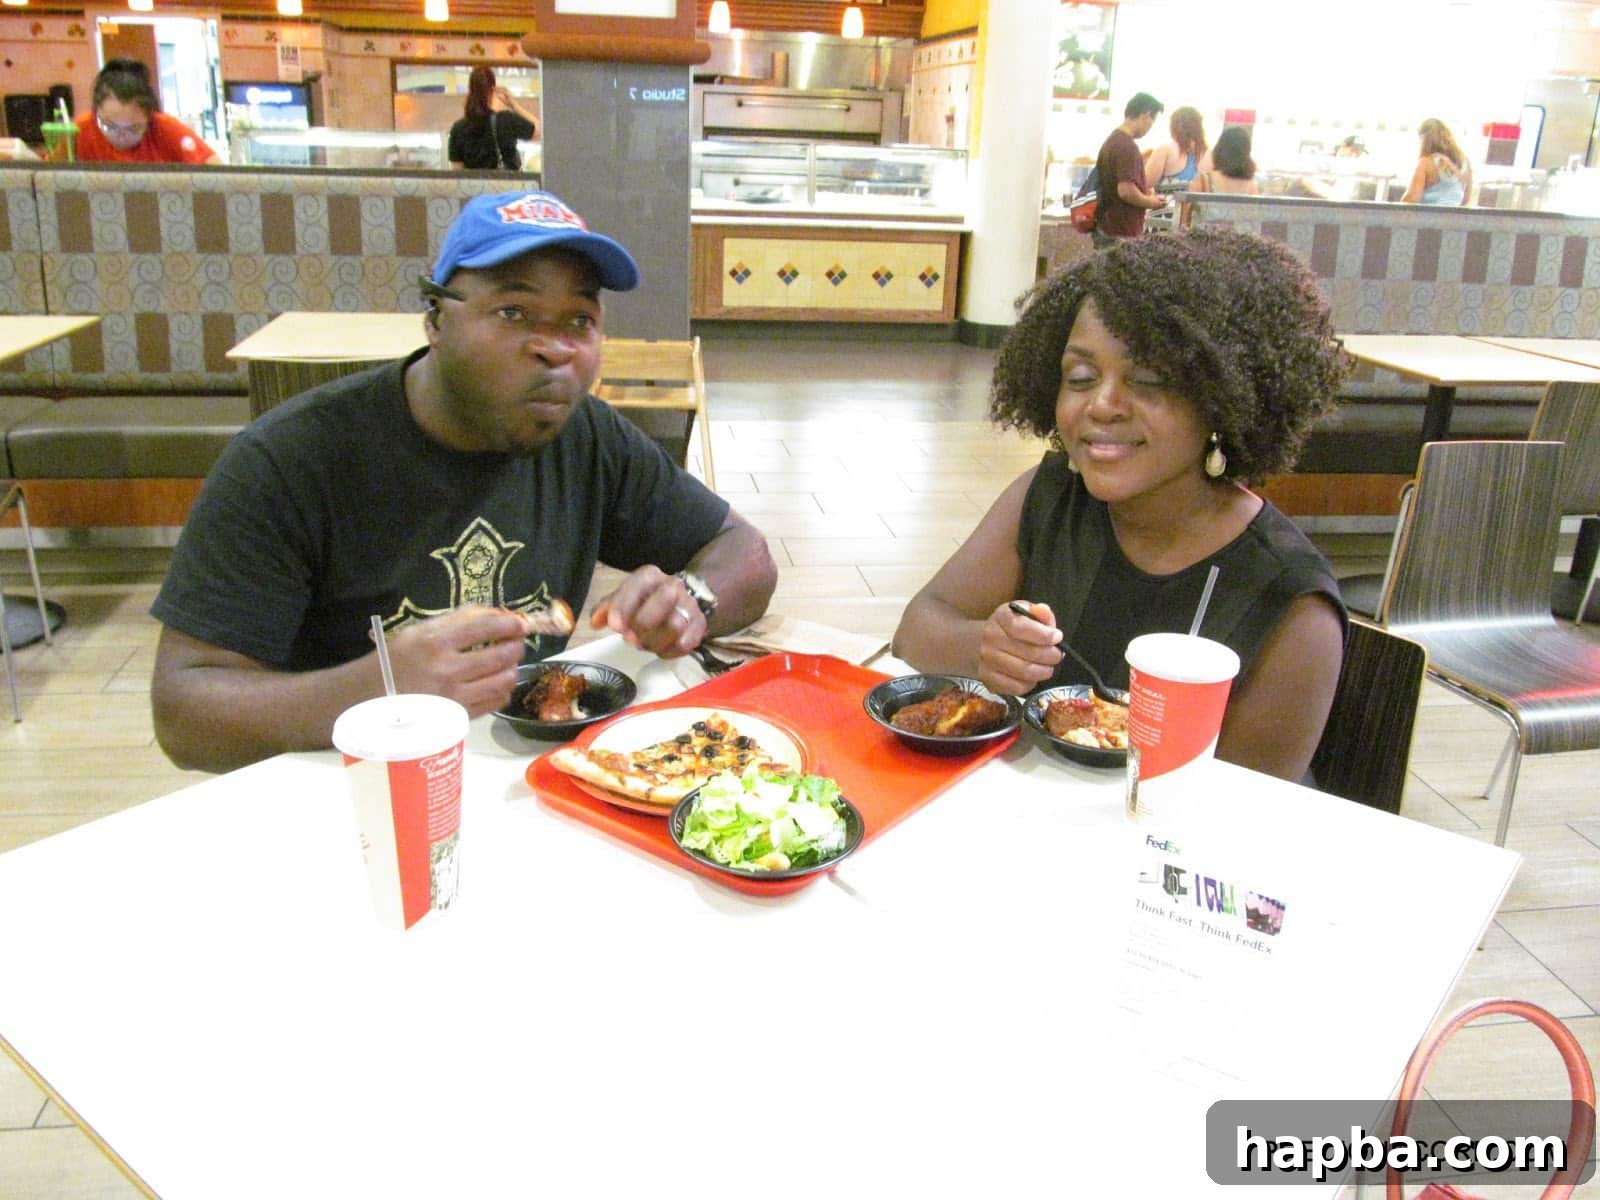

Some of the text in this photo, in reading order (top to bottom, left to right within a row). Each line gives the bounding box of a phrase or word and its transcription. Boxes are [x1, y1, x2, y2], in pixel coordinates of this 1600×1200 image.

[1146, 834, 1182, 855] FedEx
[1135, 898, 1166, 919] Think
[1200, 921, 1233, 943] Think
[1235, 934, 1273, 955] FedEx
